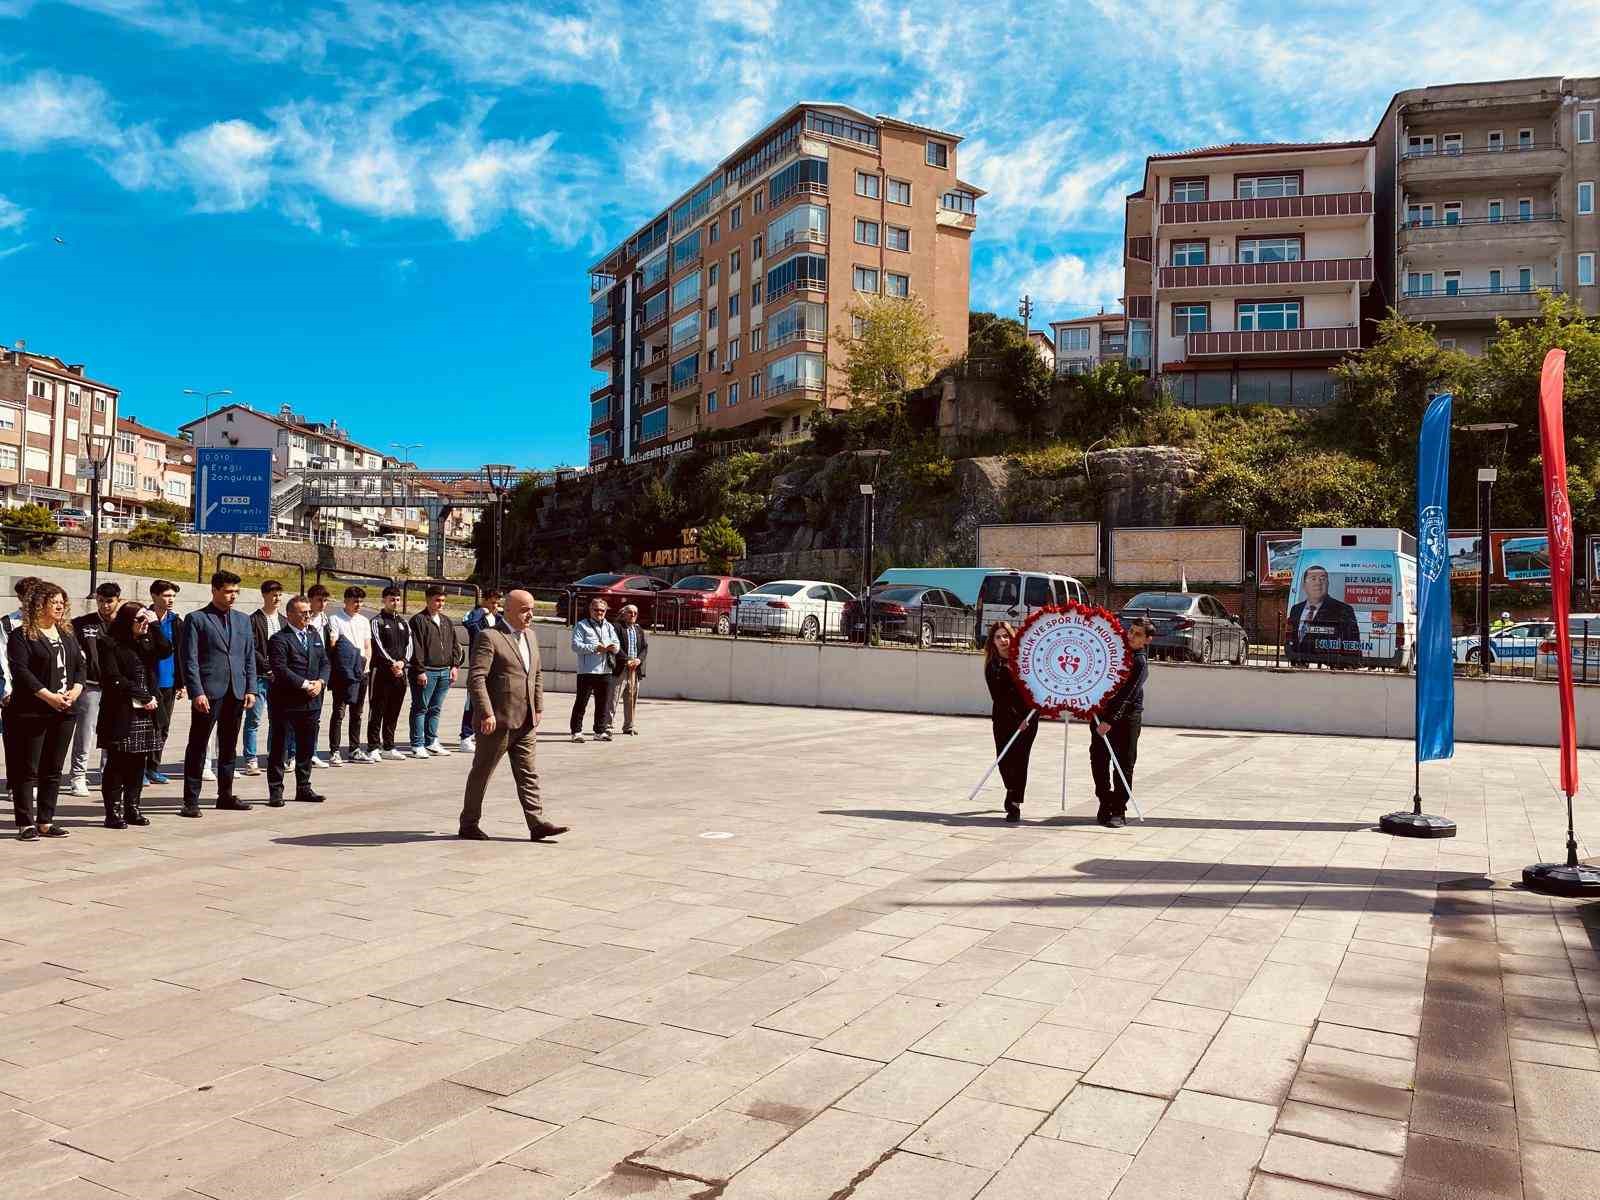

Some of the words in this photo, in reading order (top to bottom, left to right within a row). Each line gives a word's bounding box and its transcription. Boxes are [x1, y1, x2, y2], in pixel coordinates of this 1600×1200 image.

[211, 474, 263, 483] Zonguldak
[642, 547, 677, 568] ALAPLI
[1360, 575, 1392, 584] VARSAK
[1022, 638, 1036, 675] GENÇLİK
[1033, 625, 1046, 637] VE
[1045, 616, 1072, 629] SPOR
[1074, 616, 1096, 628] İLÇE
[1094, 625, 1119, 681] MÜDÜRLÜĞÜ
[1044, 696, 1091, 706] ALAPLI
